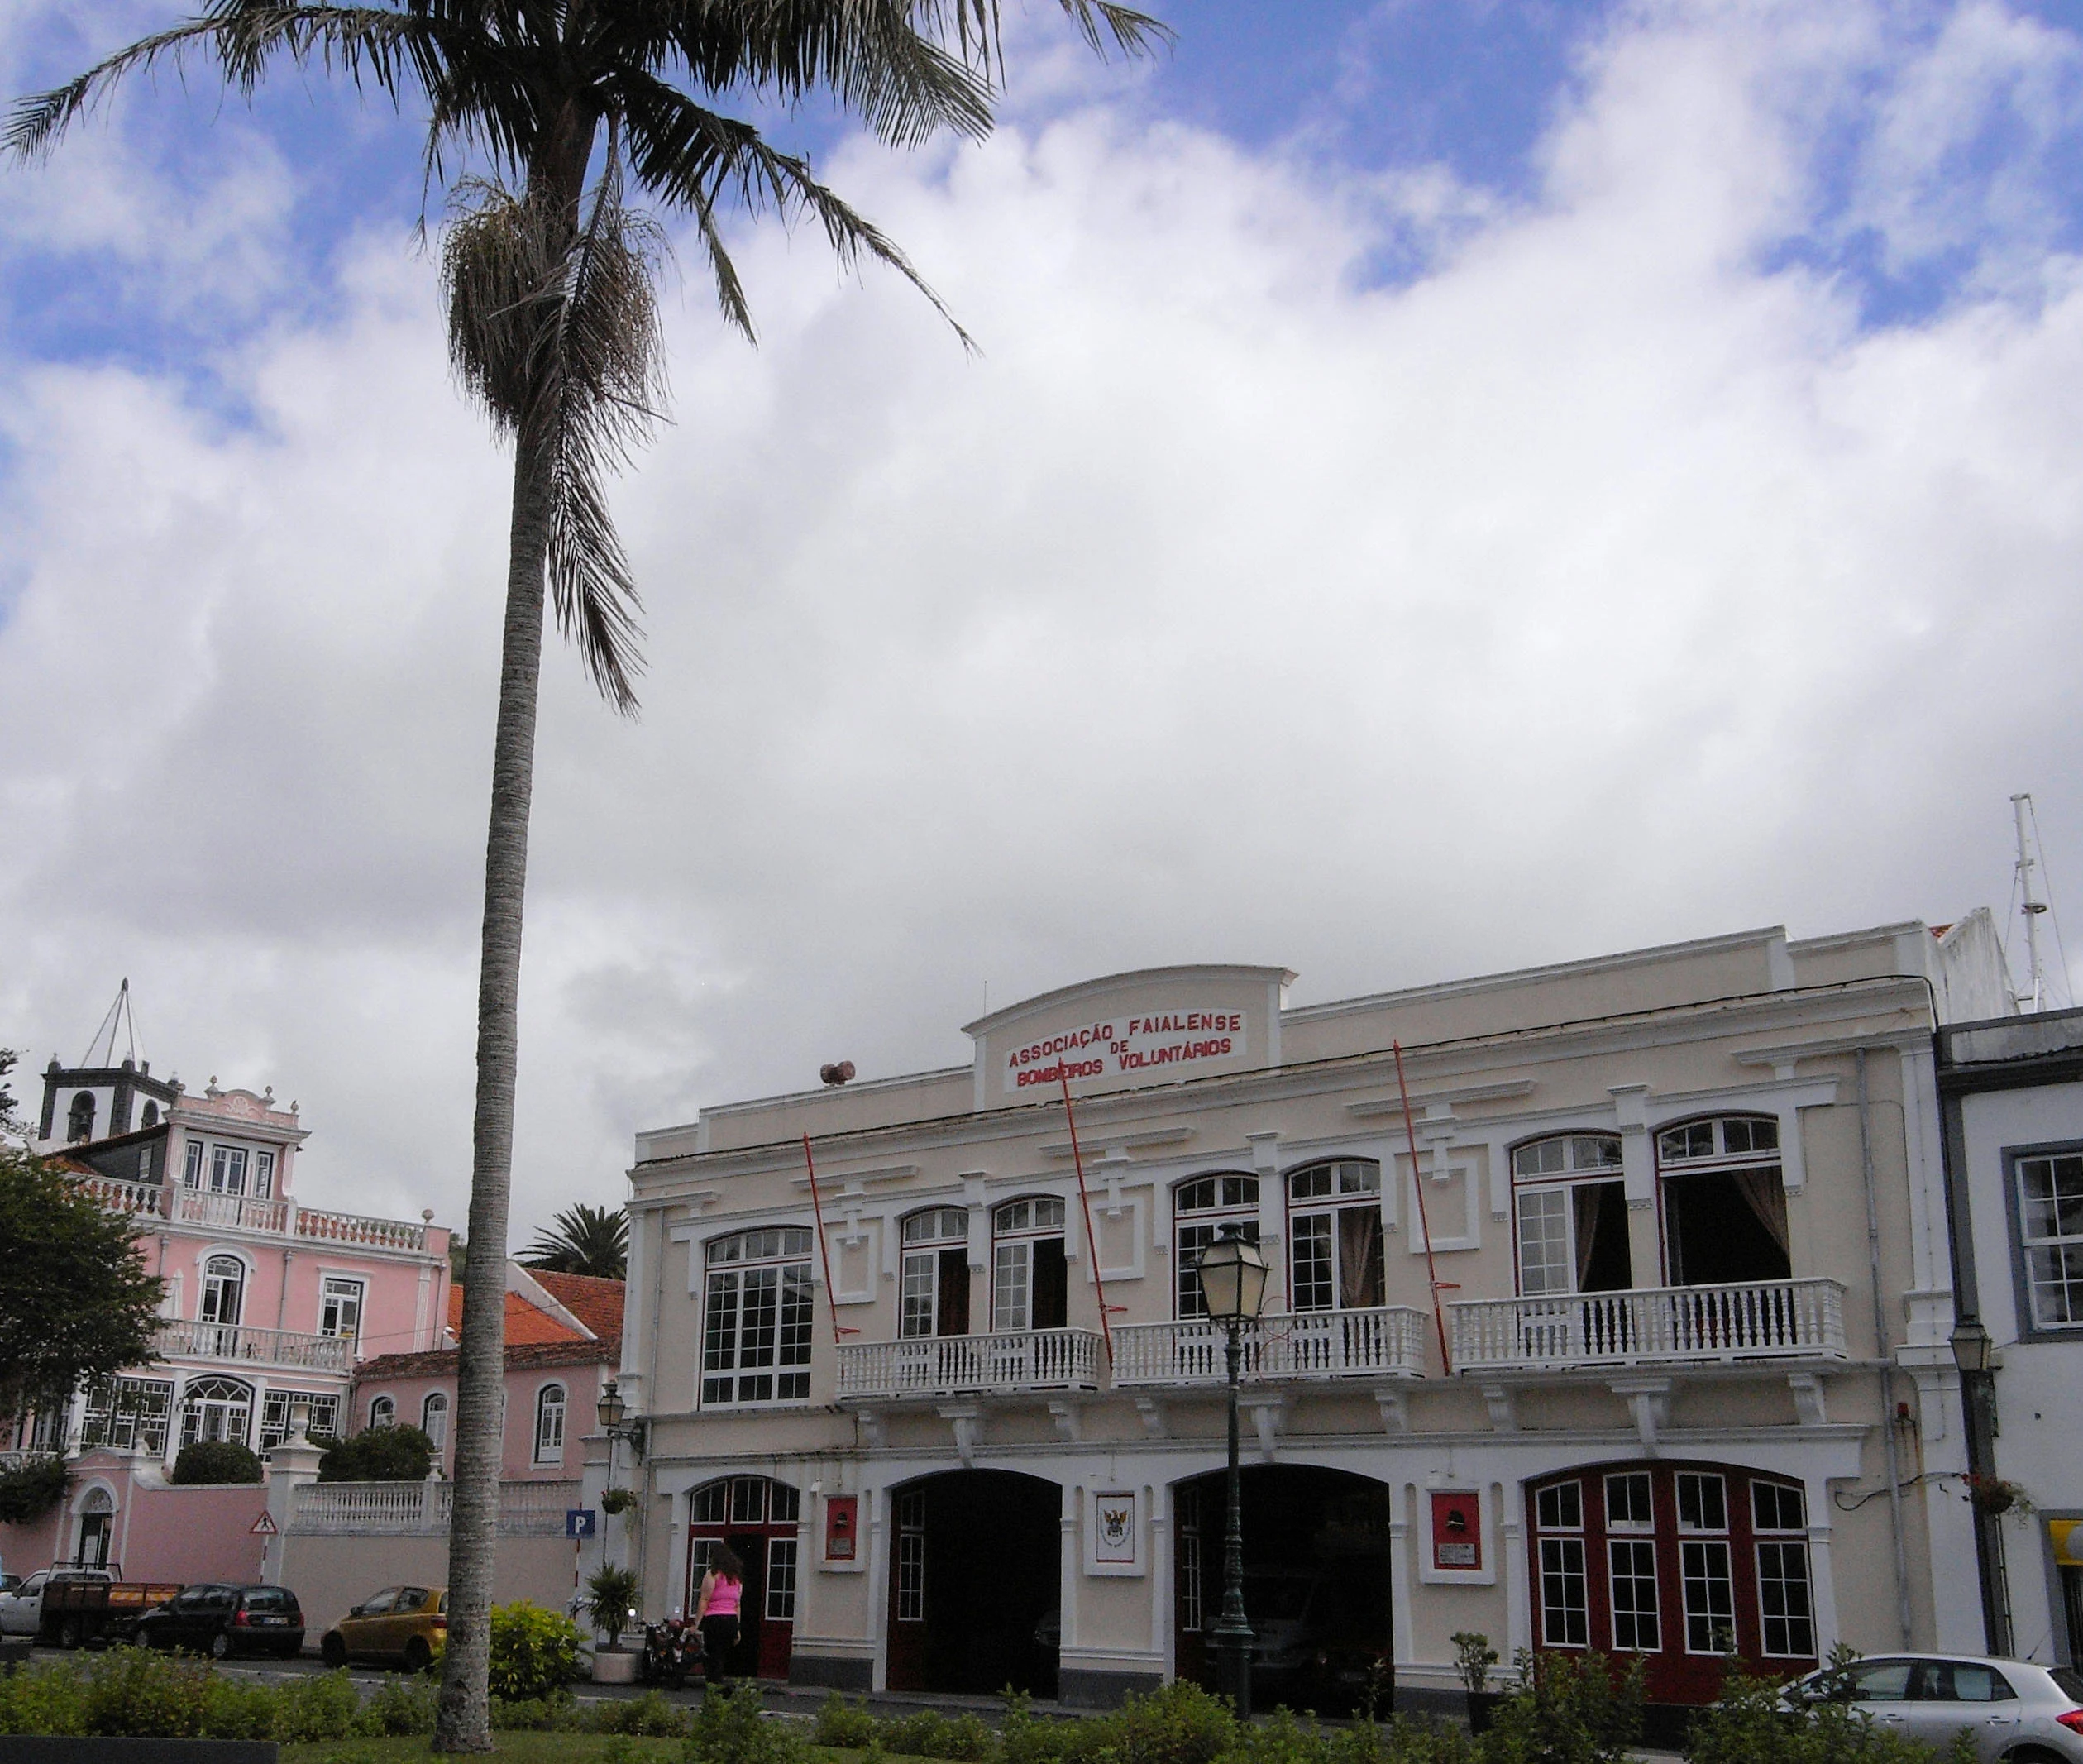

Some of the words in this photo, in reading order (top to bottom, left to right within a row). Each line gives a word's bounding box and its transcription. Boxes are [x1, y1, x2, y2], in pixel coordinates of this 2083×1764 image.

[1009, 1023, 1113, 1068] ASSOCIAÇÃO
[1129, 1013, 1241, 1035] FAIALENSE
[1110, 1040, 1129, 1054] DE
[1119, 1038, 1231, 1070] VOLUNTÁRIOS
[575, 1515, 586, 1534] P
